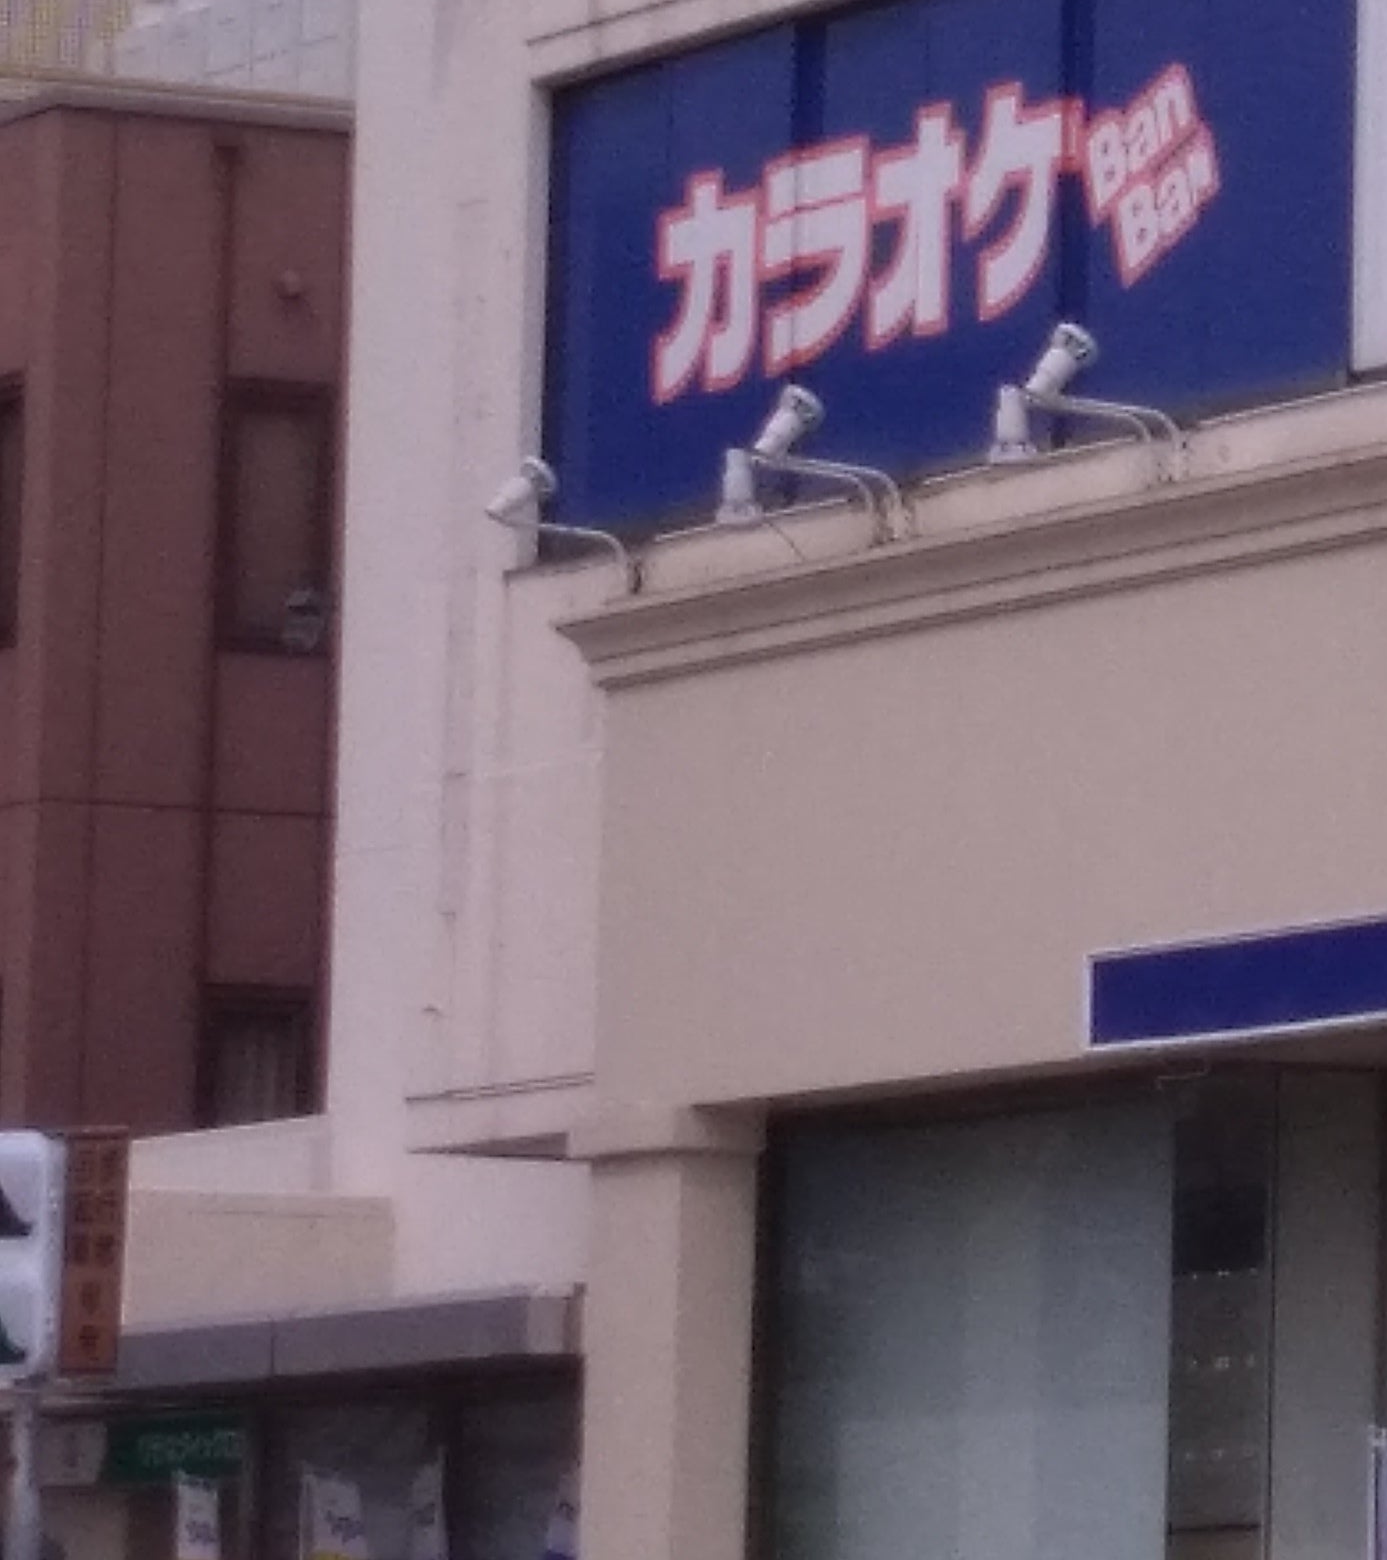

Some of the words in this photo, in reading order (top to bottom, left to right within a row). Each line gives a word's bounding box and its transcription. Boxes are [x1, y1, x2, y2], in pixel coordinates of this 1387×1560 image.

[1088, 62, 1195, 228] Ban
[1113, 124, 1220, 288] Ban
[653, 80, 1075, 404] カラオケ
